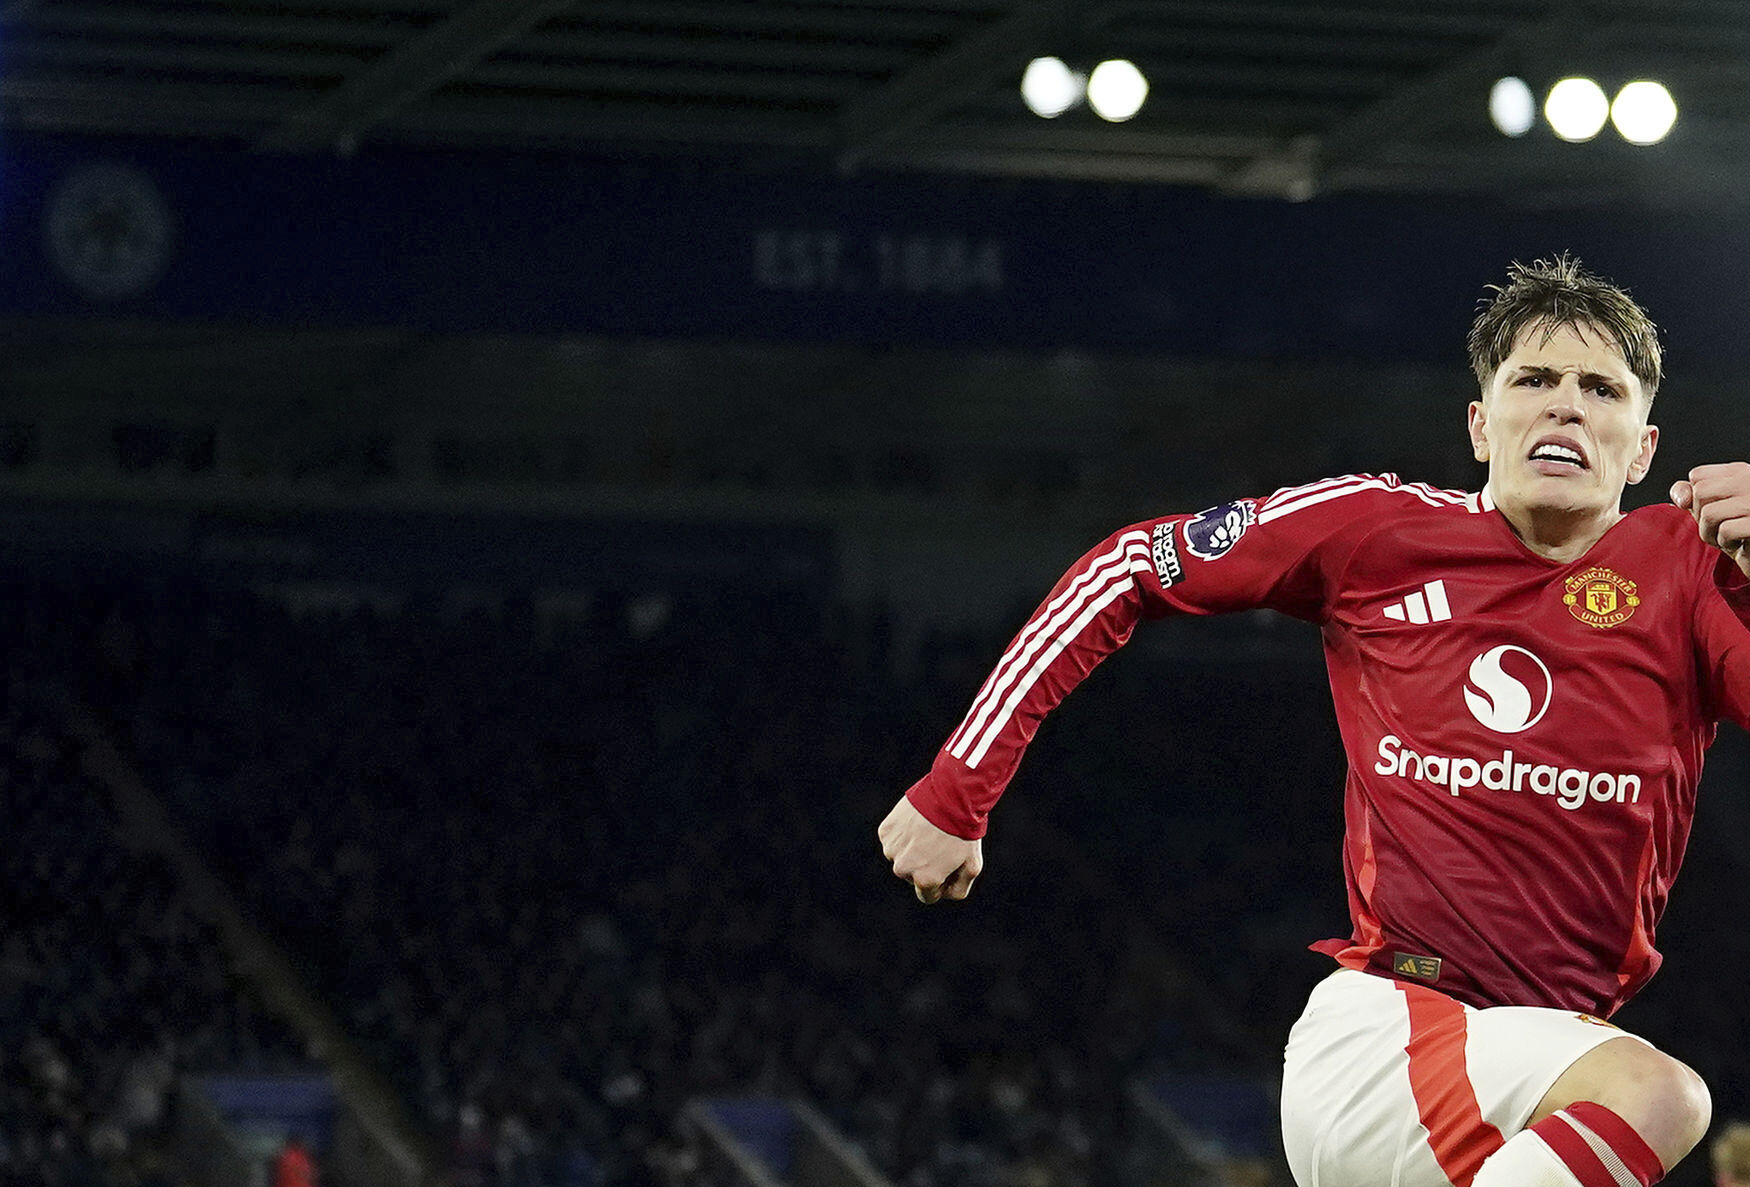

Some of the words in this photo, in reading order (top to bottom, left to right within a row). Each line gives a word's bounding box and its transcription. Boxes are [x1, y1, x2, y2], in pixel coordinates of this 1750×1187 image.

[1152, 537, 1173, 589] racism
[1162, 534, 1181, 578] room
[1571, 572, 1632, 592] MANCHESTER
[1582, 611, 1624, 623] UNITED
[1374, 735, 1641, 810] Snapdragon
